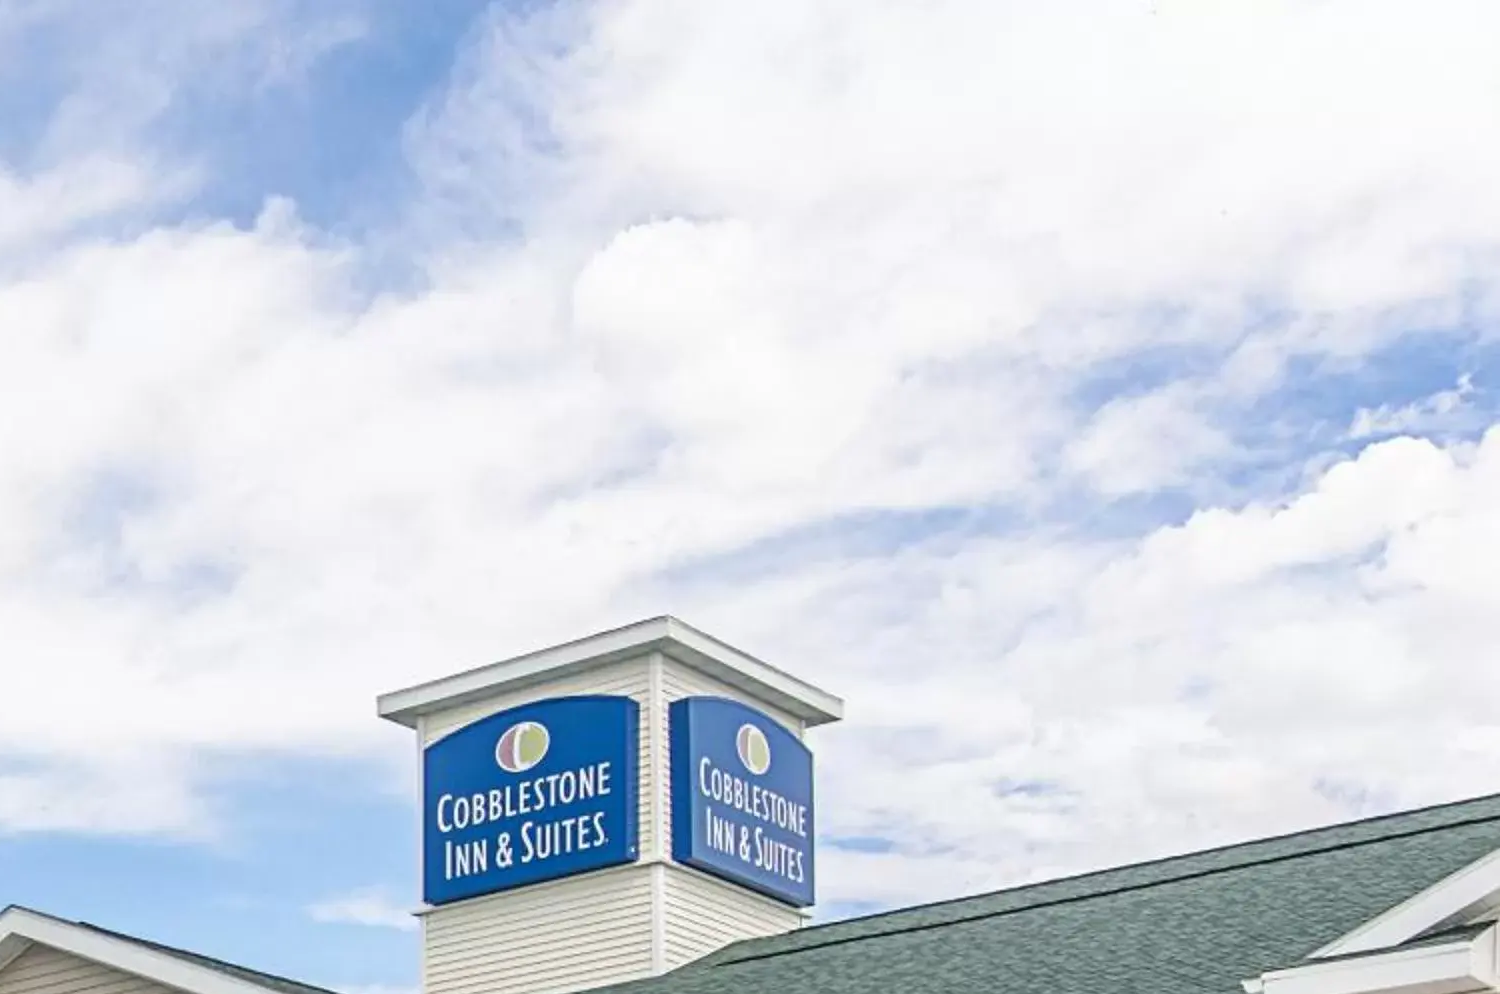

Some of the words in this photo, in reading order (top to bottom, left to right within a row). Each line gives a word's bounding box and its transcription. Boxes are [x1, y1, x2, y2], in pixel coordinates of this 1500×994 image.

[437, 762, 611, 833] COBBLESTONE
[700, 757, 807, 838] COBBLESTONE
[444, 839, 488, 881] INN
[496, 831, 513, 869] &
[521, 811, 606, 864] SUITES
[706, 807, 735, 856] INN
[739, 825, 751, 862] &
[754, 827, 805, 884] SUITES
